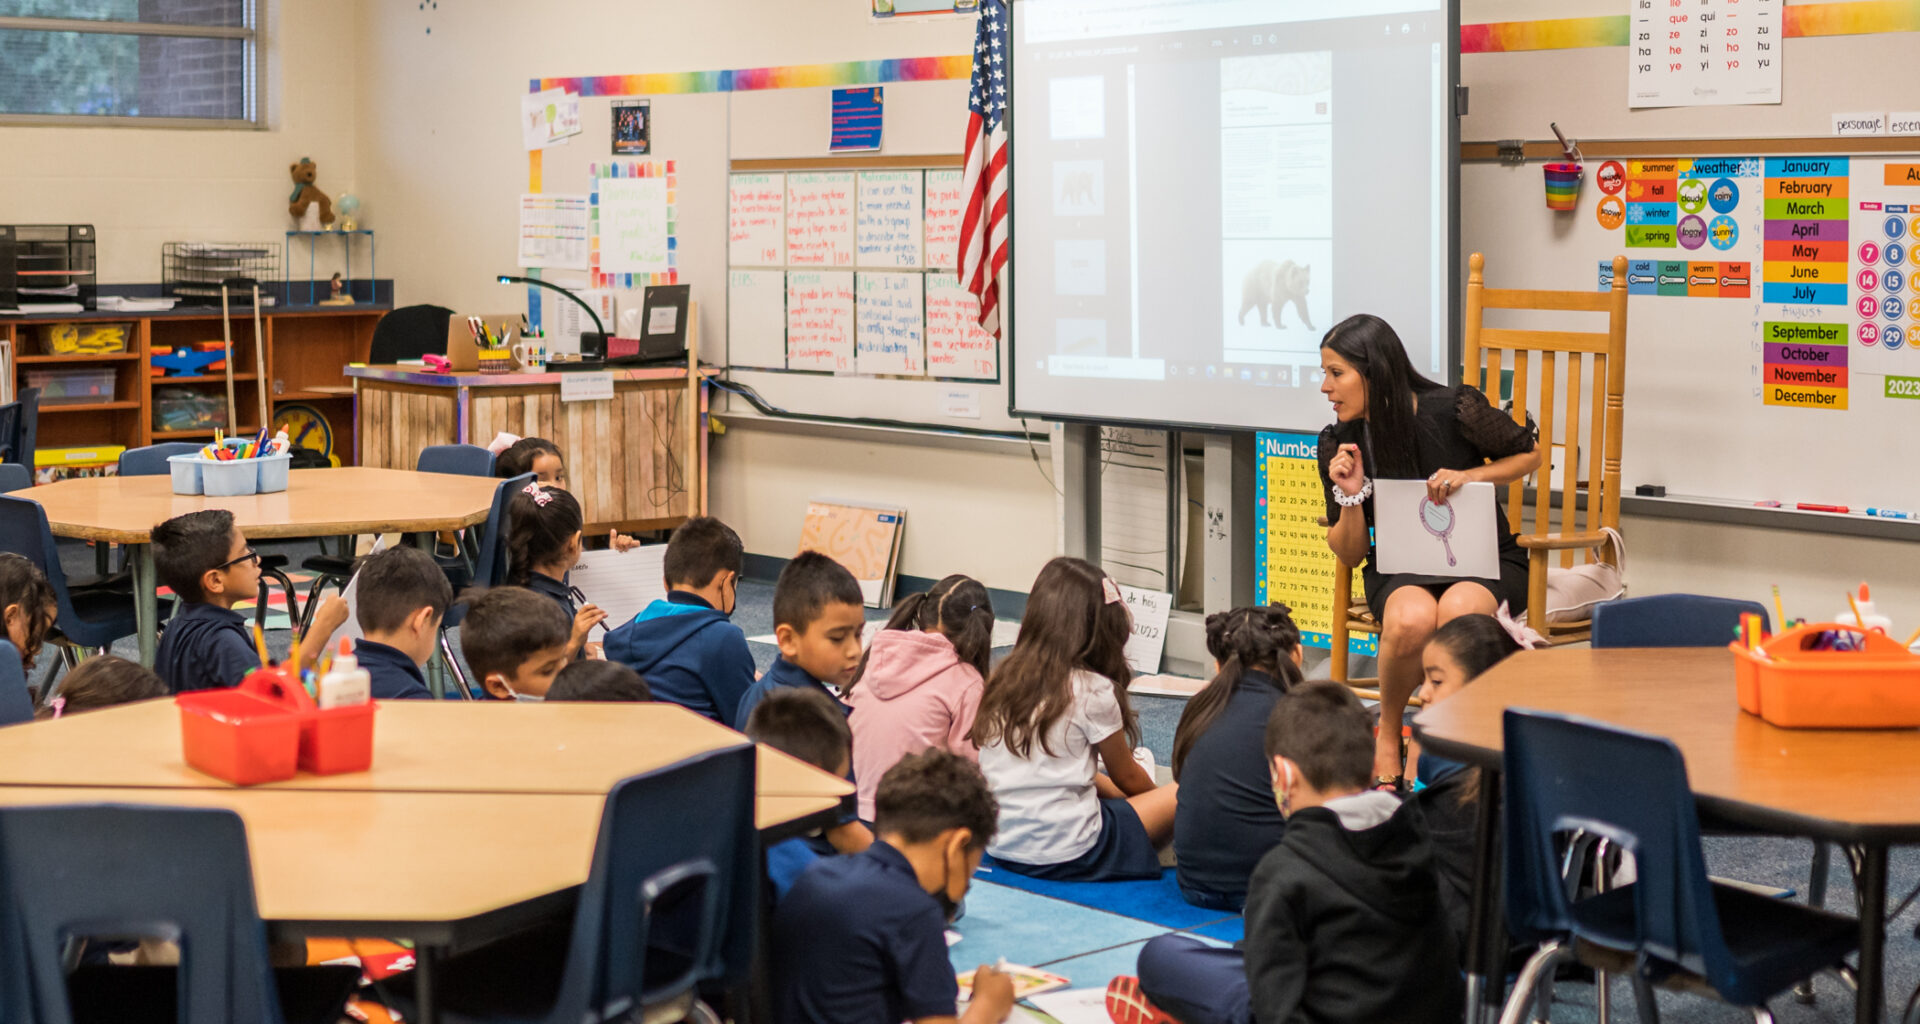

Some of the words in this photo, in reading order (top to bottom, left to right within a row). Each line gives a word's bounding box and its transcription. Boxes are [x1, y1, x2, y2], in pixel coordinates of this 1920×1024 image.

[1669, 13, 1688, 24] que
[1700, 12, 1716, 22] qui
[1638, 32, 1650, 40] za
[1700, 28, 1707, 38] zi
[1758, 26, 1768, 34] zu
[1638, 47, 1651, 56] ha
[1669, 46, 1682, 54] he
[1700, 44, 1709, 53] hi
[1727, 43, 1739, 52] ho
[1758, 41, 1770, 50] hu
[1638, 63, 1651, 74] ya
[1669, 62, 1682, 72] ye
[1700, 60, 1709, 71] yi
[1727, 60, 1739, 70] yo
[1758, 58, 1770, 68] yu
[1837, 118, 1882, 134] personaje
[1892, 121, 1920, 132] escen
[1642, 164, 1674, 172] summer
[1694, 160, 1742, 174] weather
[1782, 160, 1830, 175] January
[1907, 168, 1920, 181] Au
[1652, 186, 1664, 195] fall
[1779, 180, 1832, 196] February
[1681, 194, 1703, 204] cloudy
[1714, 192, 1732, 201] rainy
[1601, 208, 1621, 219] snowy
[1646, 209, 1670, 217] winter
[1786, 202, 1824, 215] March
[1645, 231, 1670, 242] spring
[1682, 228, 1702, 238] foggy
[1712, 229, 1733, 238] sunny
[1792, 223, 1819, 239] April
[1792, 244, 1819, 260] May
[1866, 247, 1873, 259] 7
[1890, 248, 1898, 260] 8
[1600, 264, 1613, 272] free
[1636, 263, 1650, 271] cold
[1666, 264, 1680, 272] cool
[1729, 264, 1741, 272] hot
[1790, 266, 1819, 278] June
[1862, 274, 1874, 286] 14
[1888, 275, 1898, 287] 15
[1792, 286, 1816, 302] July
[1862, 300, 1874, 312] 21
[1885, 301, 1900, 314] 22
[1772, 325, 1838, 341] September
[1862, 327, 1875, 339] 28
[1885, 331, 1900, 342] 29
[1781, 347, 1830, 362] October
[1774, 368, 1837, 383] November
[1888, 379, 1920, 395] 2023
[1775, 388, 1837, 404] December
[1266, 438, 1318, 457] Numbe
[1126, 592, 1136, 604] de
